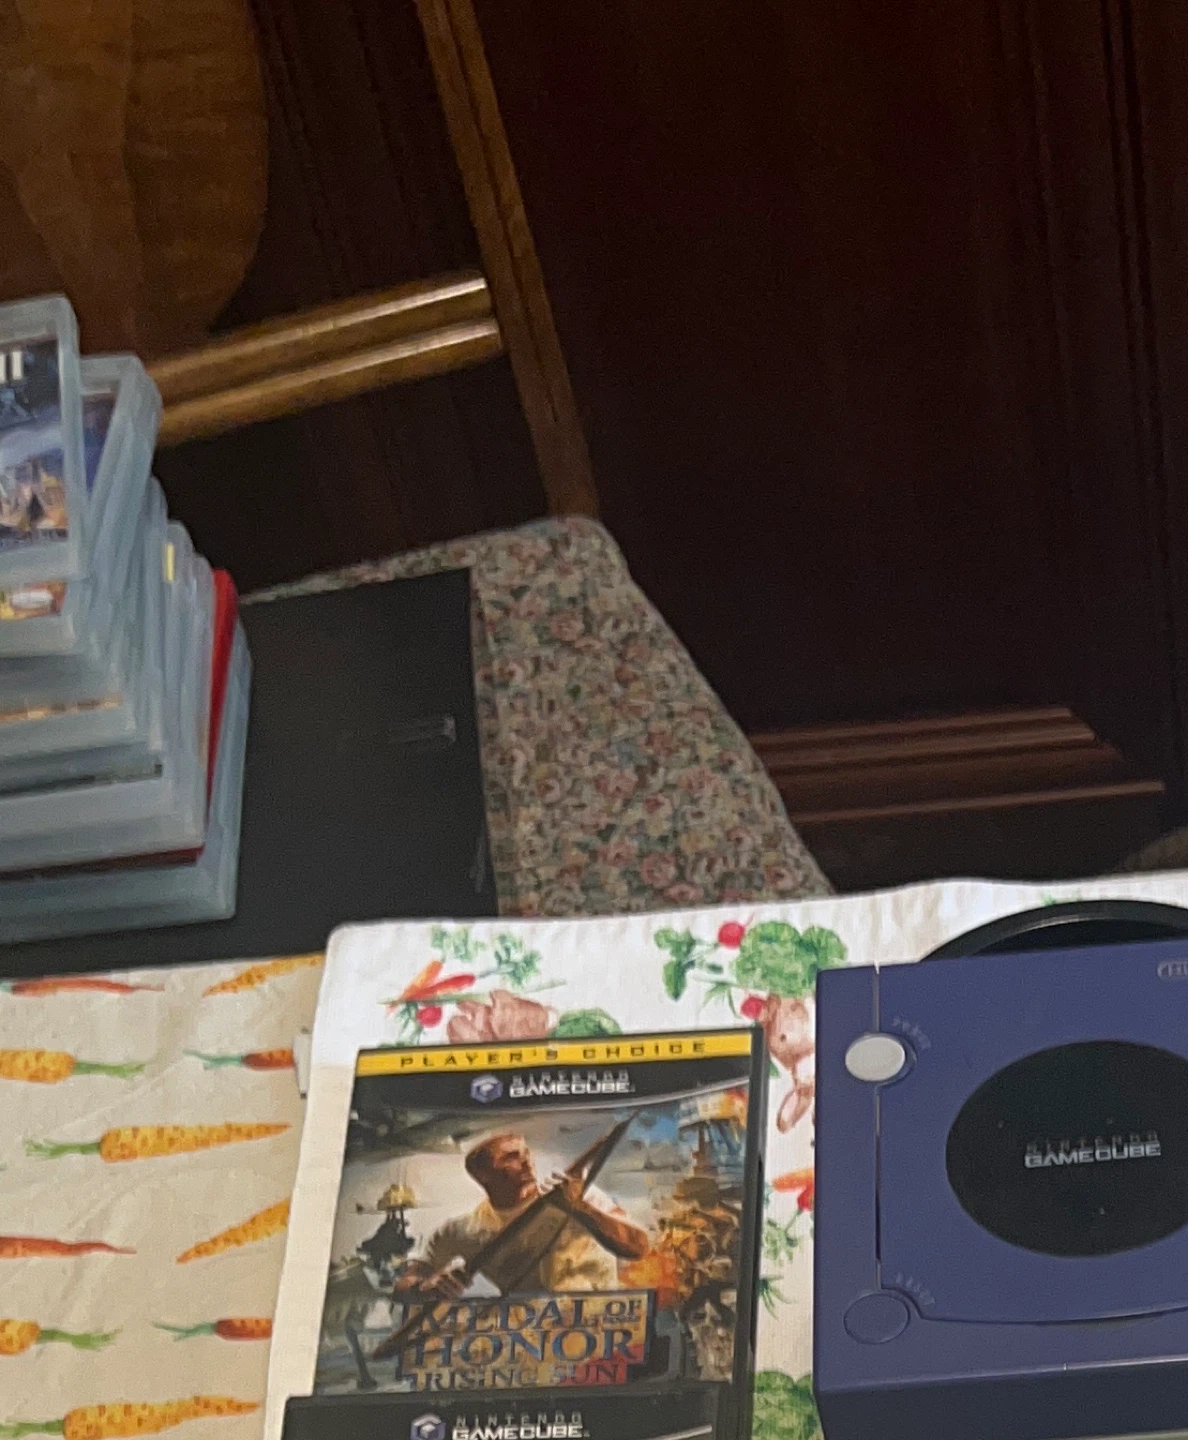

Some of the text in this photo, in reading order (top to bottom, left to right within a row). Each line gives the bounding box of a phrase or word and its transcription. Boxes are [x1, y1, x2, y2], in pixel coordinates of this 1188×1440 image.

[401, 1041, 706, 1068] PLAYER'S CHOICE
[509, 1081, 631, 1098] GAMECUBE
[1024, 1141, 1162, 1169] GAMECUBE
[414, 1328, 638, 1367] HONOR
[455, 1411, 583, 1428] NINTENDO
